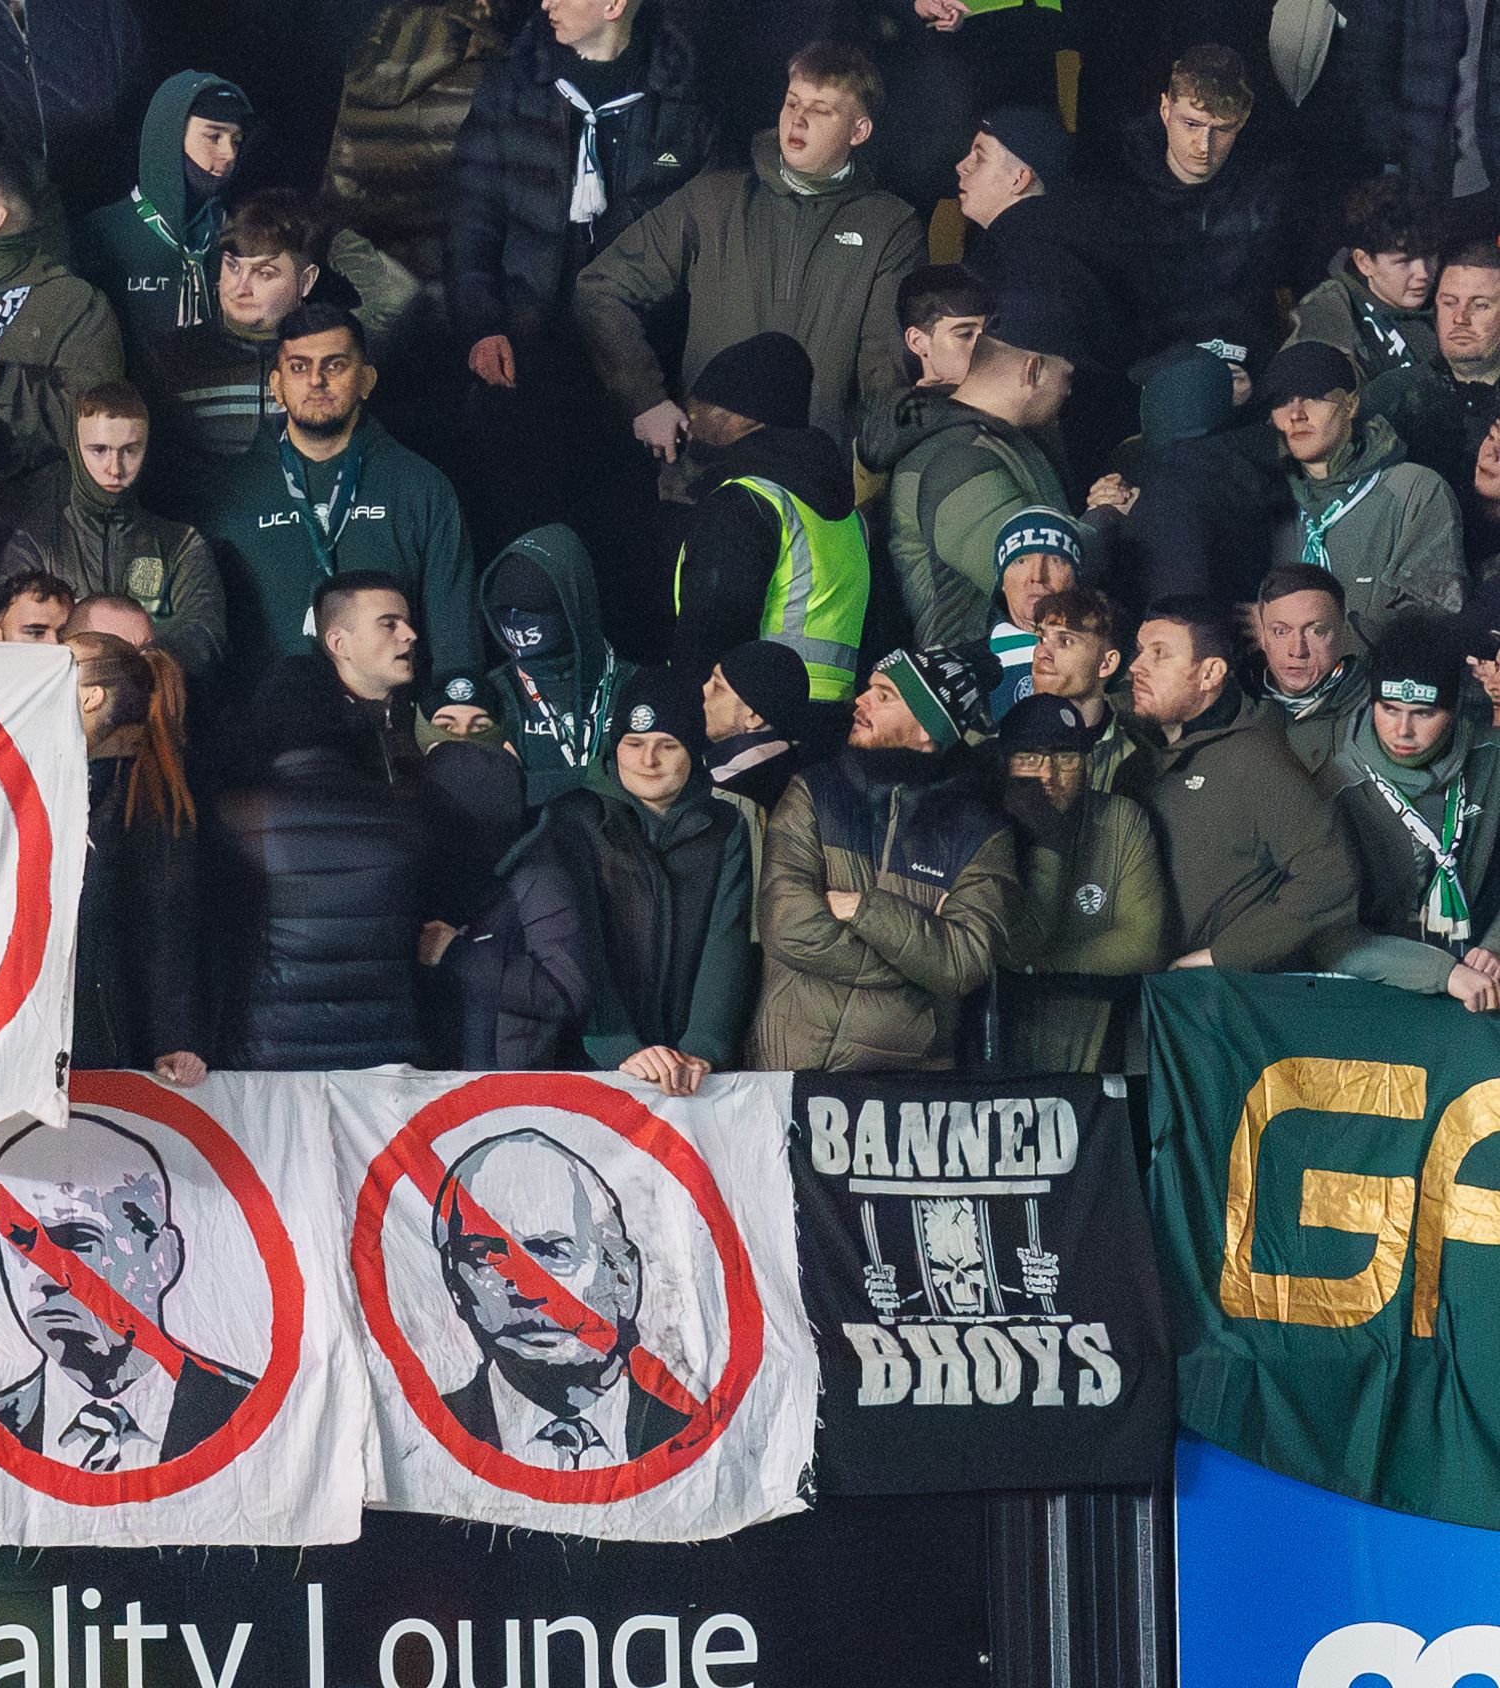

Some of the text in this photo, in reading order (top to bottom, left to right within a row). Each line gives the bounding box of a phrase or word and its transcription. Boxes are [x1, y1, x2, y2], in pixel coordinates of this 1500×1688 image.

[998, 527, 1081, 567] CELTIC
[808, 1096, 1079, 1178] BANNED
[842, 1322, 1122, 1407] BHOYS
